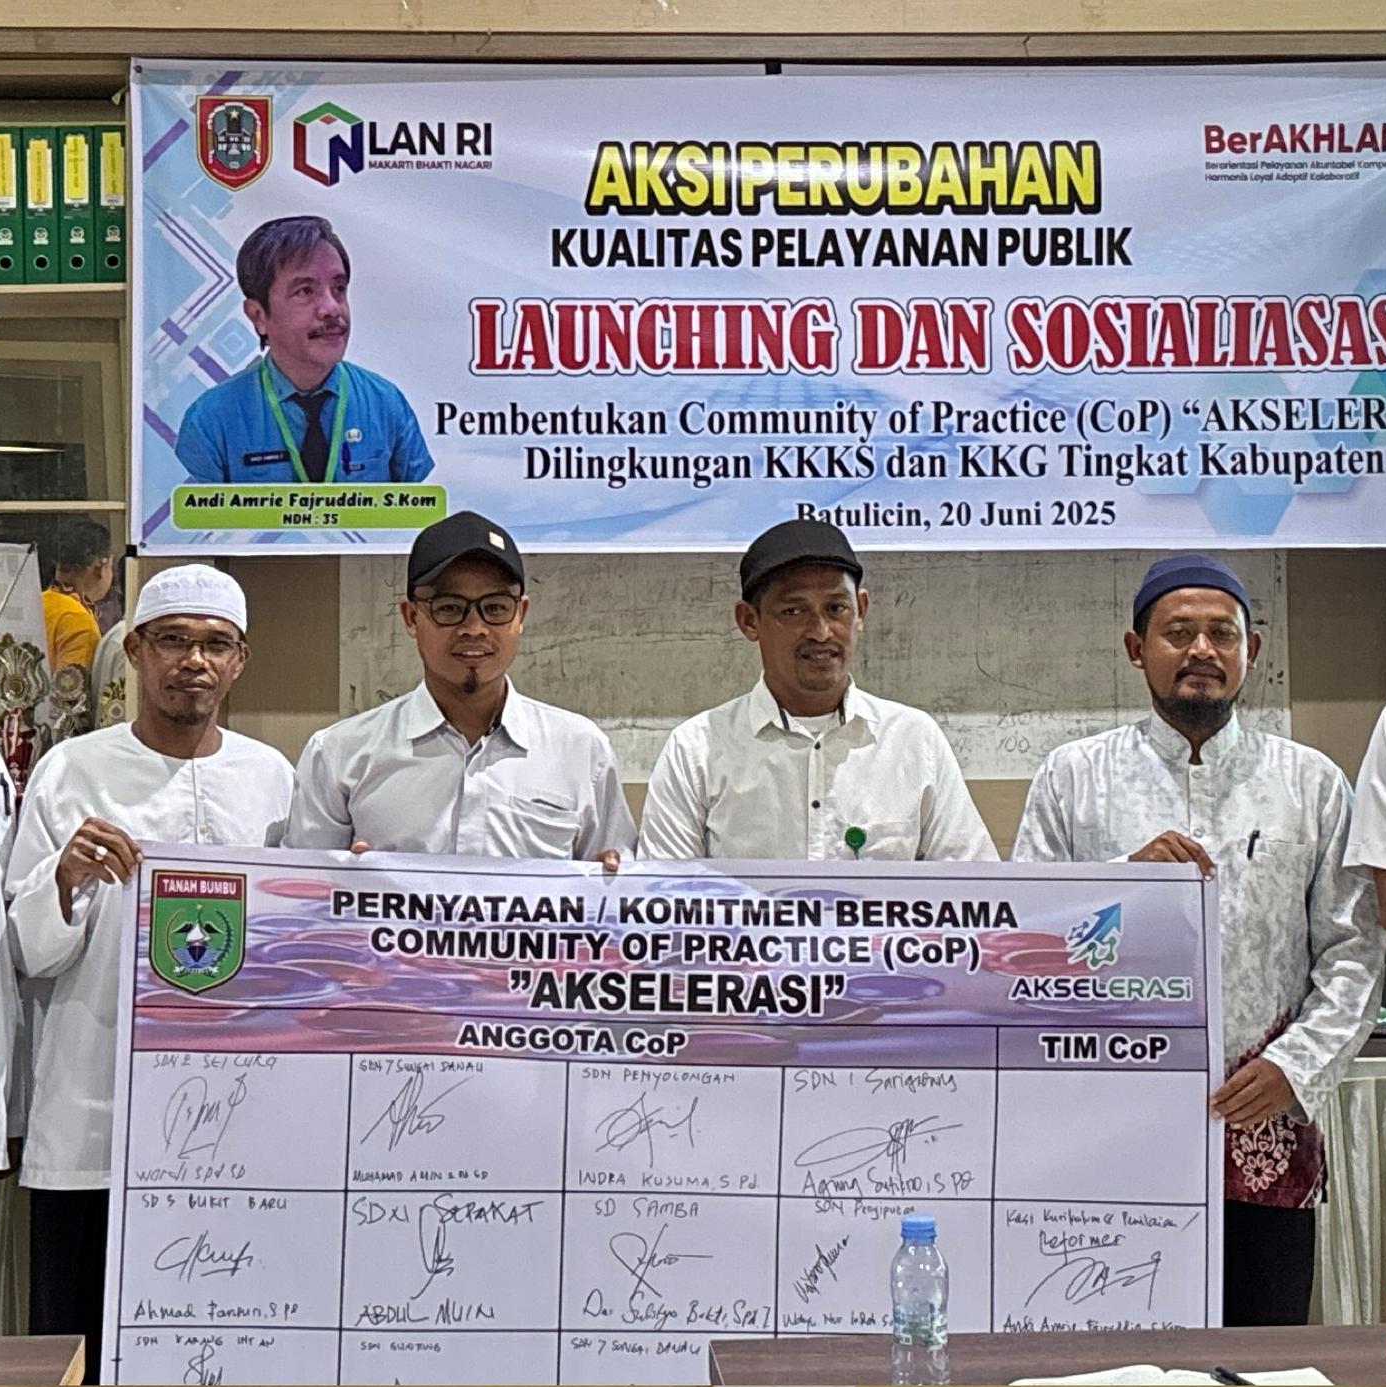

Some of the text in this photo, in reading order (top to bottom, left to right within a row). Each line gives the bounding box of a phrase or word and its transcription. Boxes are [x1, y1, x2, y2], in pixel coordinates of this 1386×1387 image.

[369, 121, 492, 155] LAN RI
[368, 160, 493, 170] MAKARTI BHAKTI NAGARI
[585, 142, 1101, 215] AKSI PERUBAHAN
[1205, 160, 1259, 170] Berorientasi
[1261, 160, 1308, 171] Pelayanan
[1250, 172, 1274, 183] Loyal
[551, 227, 1133, 268] KUALITAS PELAYANAN PUBLIK
[472, 299, 838, 374] LAUNCHING
[854, 299, 991, 374] DAN
[435, 401, 667, 436] Pembentukan
[680, 400, 878, 443] Community
[889, 400, 922, 435] of
[933, 400, 1066, 433] Practice
[1077, 399, 1172, 441] (CoP)
[524, 441, 1384, 488] Dilingkungan KKKS dan KKG Tingkat Kabupaten
[184, 492, 437, 510] Andi Amrie Fajruddin, S.Kom
[940, 502, 972, 527] 20
[980, 501, 1042, 526] Juni
[1051, 500, 1117, 526] 2025
[282, 513, 312, 525] NDH
[322, 513, 339, 525] 35
[162, 879, 237, 897] TANAH BUMBU
[332, 890, 585, 925] PERNYATAAN
[619, 896, 822, 929] KOMITMEN
[836, 900, 1018, 930] BERSAMA
[370, 927, 981, 972] COMMUNITY OF PRACTICE (CoP)
[457, 1024, 687, 1056] ANGGOTA CoP
[1040, 1035, 1169, 1060] TIM CoP
